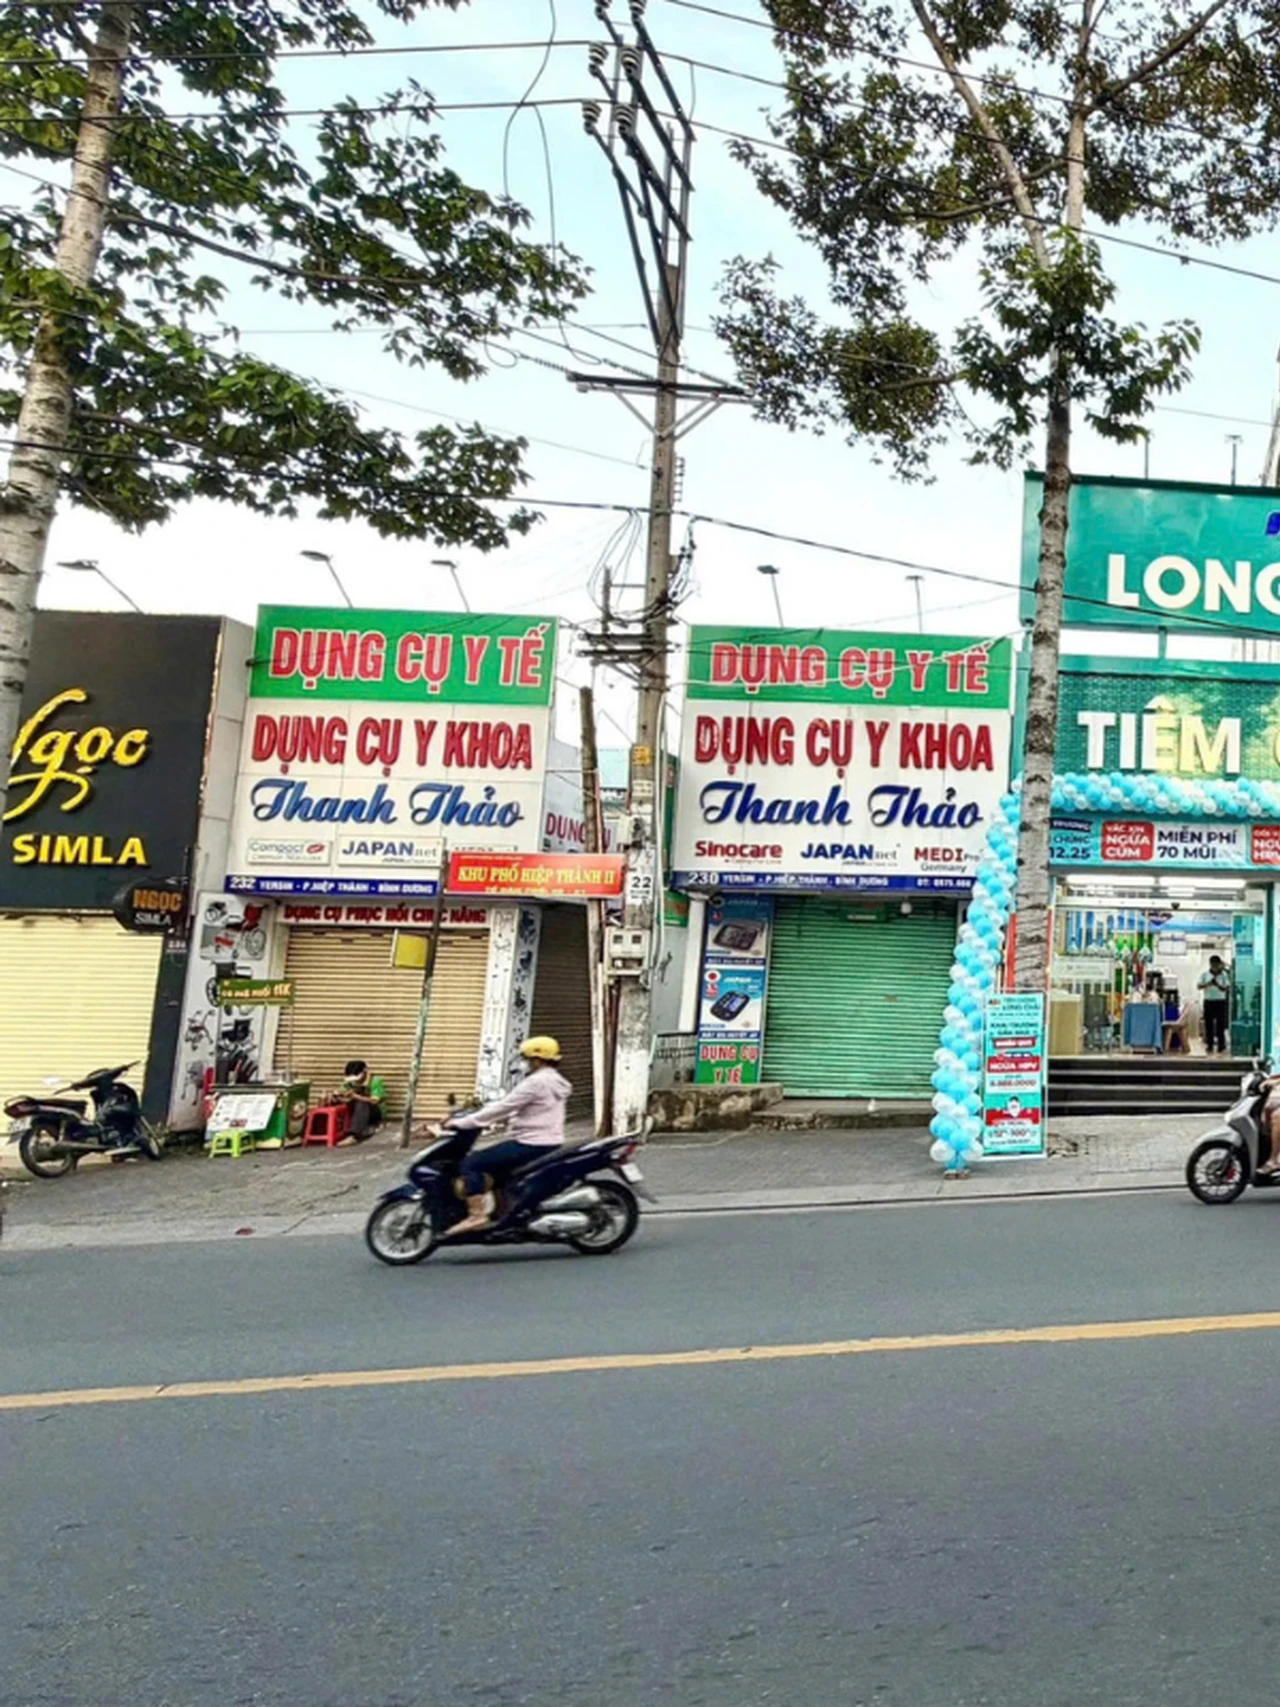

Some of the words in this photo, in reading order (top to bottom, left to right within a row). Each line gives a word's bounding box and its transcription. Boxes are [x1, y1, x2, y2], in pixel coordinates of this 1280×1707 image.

[269, 628, 386, 690] DỤNG
[395, 632, 452, 694] CỤ
[463, 634, 489, 684] Y
[498, 623, 550, 688] TẾ
[710, 643, 826, 694] DỤNG
[839, 647, 896, 698] CỤ
[908, 652, 932, 693] Y
[943, 640, 989, 693] TẾ
[1077, 694, 1241, 775] TIÊM
[251, 713, 348, 775] DỤNG
[356, 717, 403, 777] CỤ
[414, 720, 437, 766] Y
[442, 720, 533, 770] KHOA
[695, 715, 795, 775] DỤNG
[805, 717, 853, 779] CỤ
[865, 721, 889, 768] Y
[899, 722, 994, 772] KHOA
[251, 778, 398, 822] Thanh
[409, 782, 524, 829] Thảo
[700, 780, 852, 825] Thanh
[867, 785, 983, 829] Thảo
[1106, 834, 1150, 846] NGỪA
[1157, 826, 1202, 844] MIỄN
[1207, 829, 1237, 845] PHÍ
[13, 832, 147, 865] SIMLA
[695, 841, 782, 858] Sinocare
[1105, 846, 1141, 858] CÚM
[1157, 846, 1180, 859] 70
[1184, 845, 1216, 860] MŨI
[458, 866, 487, 881] KHU
[490, 862, 518, 881] PHỐ
[521, 864, 553, 884] HIỆP
[556, 866, 601, 883] THÀNH
[921, 862, 967, 873] Germany
[231, 877, 255, 890] 232
[631, 876, 652, 888] 22
[689, 872, 718, 885] 230
[133, 889, 182, 914] NGỌC
[285, 905, 320, 921] DỤNG
[324, 906, 342, 922] CỤ
[450, 906, 486, 923] NĂNG
[701, 1045, 737, 1064] DỤNG
